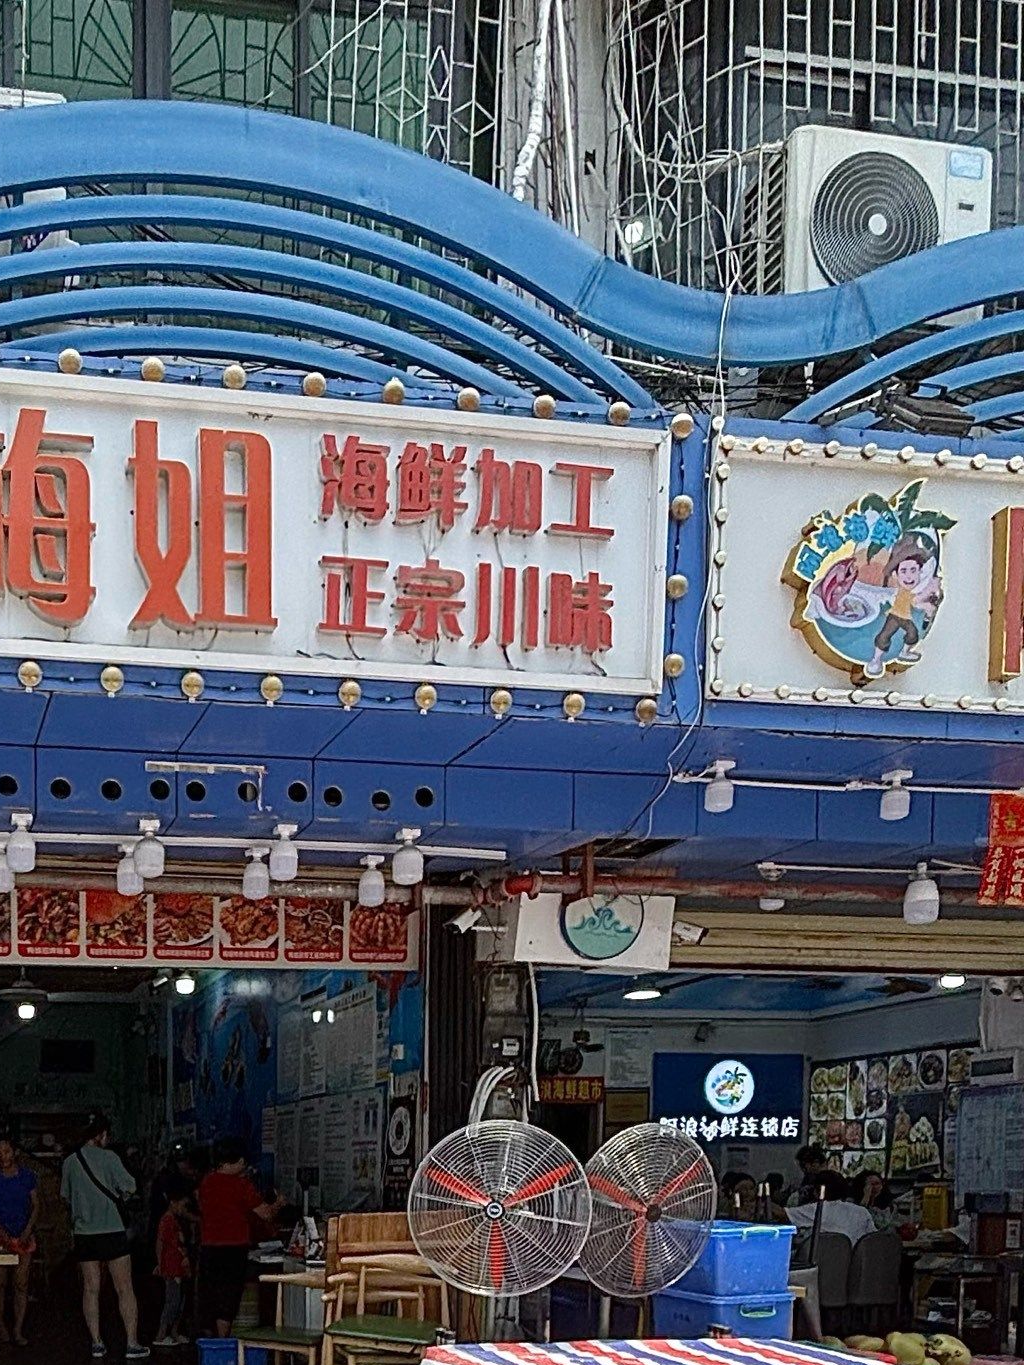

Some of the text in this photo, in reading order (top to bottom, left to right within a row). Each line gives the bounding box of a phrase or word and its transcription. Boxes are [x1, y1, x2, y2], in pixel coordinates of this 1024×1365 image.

[320, 434, 616, 539] 海鲜加工
[319, 555, 615, 653] 正宗川味
[659, 1115, 800, 1141] 阿浪海鲜连锁店
